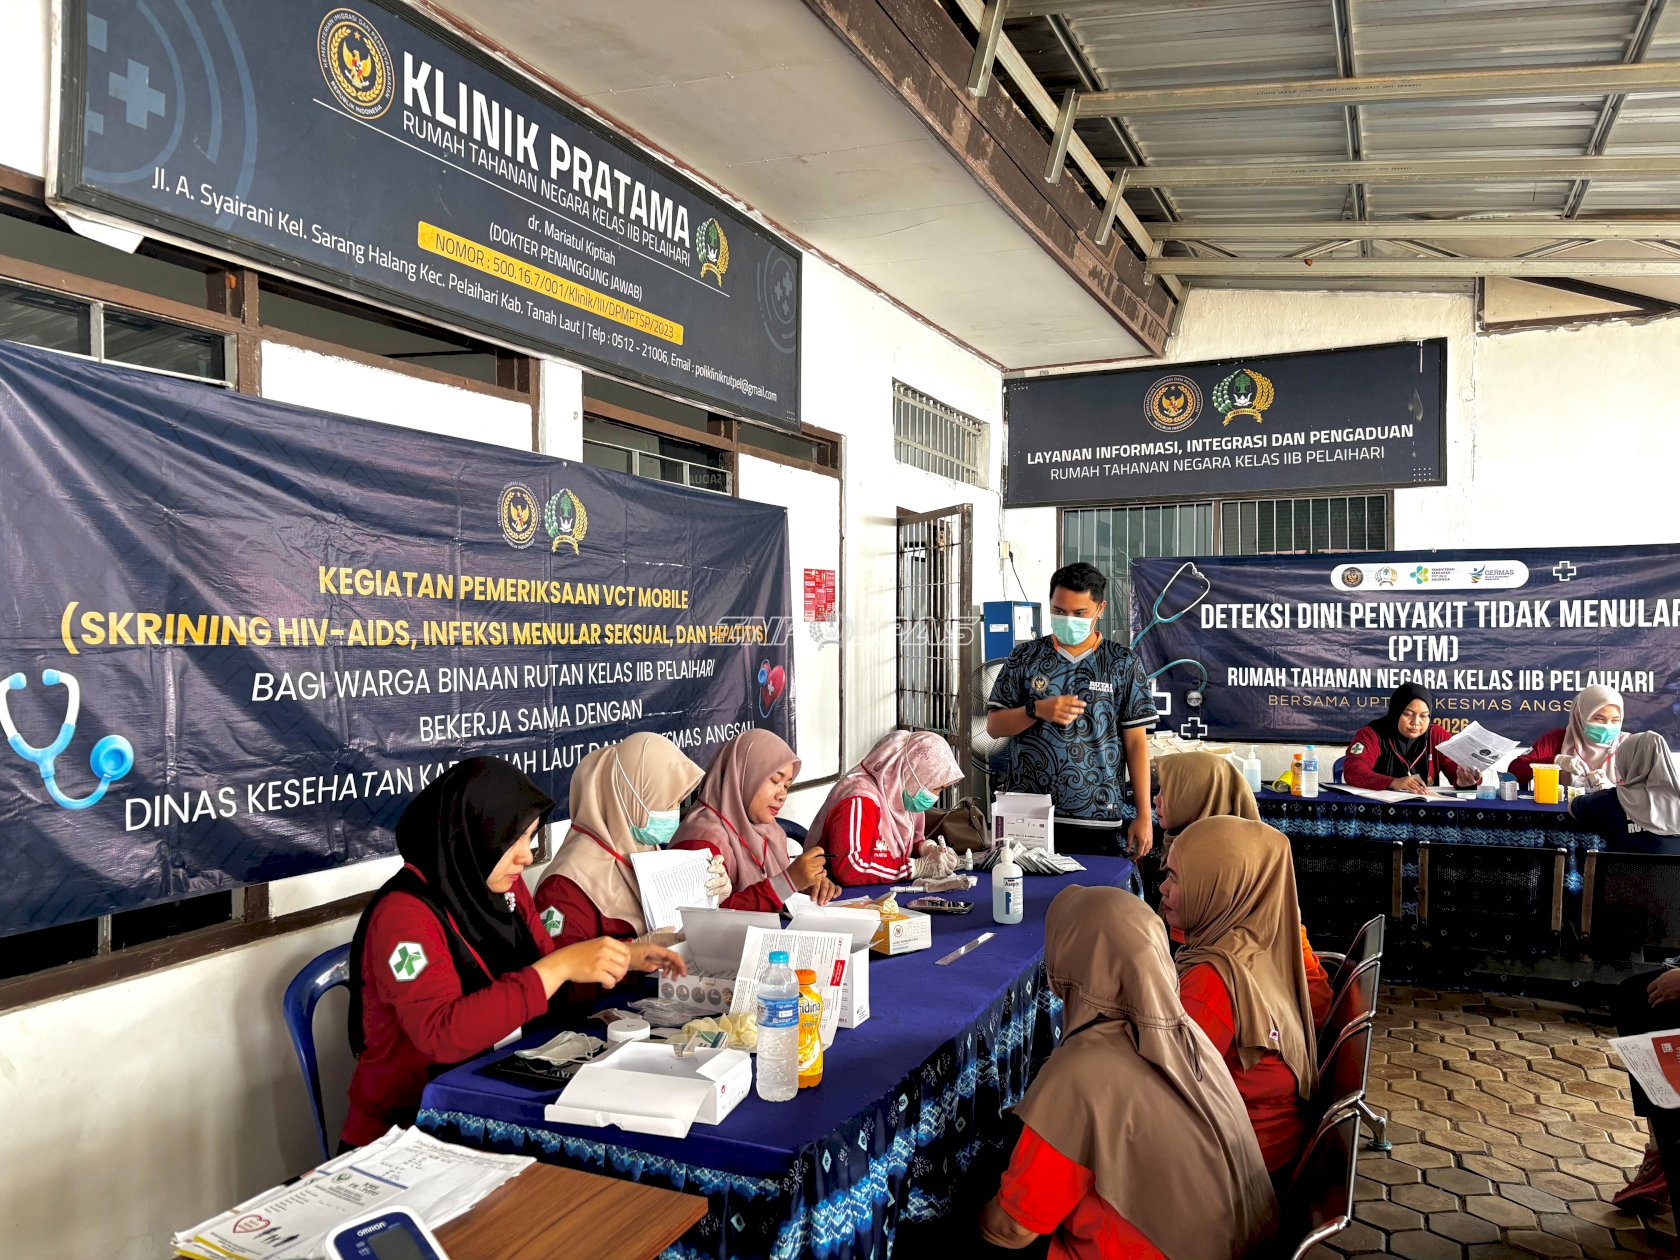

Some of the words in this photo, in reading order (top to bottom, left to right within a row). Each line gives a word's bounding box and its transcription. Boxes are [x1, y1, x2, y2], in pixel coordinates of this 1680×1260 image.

[404, 51, 540, 171] KLINIK
[550, 133, 690, 249] PRATAMA
[403, 110, 465, 158] RUMAH
[469, 142, 537, 193] TAHANAN
[541, 179, 589, 221] NEGARA
[593, 205, 625, 236] KELAS
[627, 222, 640, 243] IIB
[642, 230, 690, 268] PELAIHARI
[435, 233, 485, 268] NOMOR
[528, 214, 542, 233] dr.
[544, 221, 584, 252] Mariatul
[586, 237, 616, 266] Kiptiah
[489, 222, 538, 258] (DOKTER
[541, 247, 608, 287] PENANGGUNG
[610, 275, 642, 302] JAWAB)
[152, 167, 170, 192] Jl.
[175, 175, 195, 200] A.
[200, 184, 273, 227] Syairani
[278, 211, 308, 239] Kel.
[311, 224, 365, 264] Sarang
[368, 244, 417, 282] Halang
[420, 263, 445, 288] Kec.
[449, 273, 499, 305] Pelaihari
[501, 292, 523, 315] Kab.
[526, 301, 557, 326] Tanah
[559, 312, 580, 335] Laut
[612, 332, 634, 352] 0512
[642, 343, 669, 366] 21006,
[671, 353, 691, 371] Email
[695, 364, 778, 402] poliklinikrutpel@gmail.com
[1028, 448, 1092, 465] LAYANAN
[1096, 441, 1182, 459] INFORMASI,
[1187, 434, 1267, 453] INTEGRASI
[1272, 431, 1305, 447] DAN
[1310, 424, 1414, 445] PENGADUAN
[1050, 465, 1100, 480] RUMAH
[1103, 460, 1169, 476] TAHANAN
[1173, 456, 1231, 471] NEGARA
[1235, 452, 1280, 468] KELAS
[1284, 451, 1302, 465] IIB
[1306, 446, 1385, 464] PELAIHARI
[319, 566, 454, 600] KEGIATAN
[460, 576, 600, 605] PEMERIKSAAN
[602, 585, 635, 607] VCT
[638, 587, 689, 609] MOBILE
[60, 601, 272, 654] (SKRINING
[278, 617, 417, 650] HIV-AIDS,
[423, 620, 508, 646] INFEKSI
[513, 622, 601, 645] MENULAR
[605, 624, 673, 647] SEKSUAL,
[676, 625, 707, 644] DAN
[709, 620, 768, 646] HEPATITIS)
[1201, 603, 1290, 629] DETEKSI
[1297, 602, 1343, 629] DINI
[1350, 601, 1467, 629] PENYAKIT
[1474, 600, 1551, 628] TIDAK
[1388, 635, 1459, 662] (PTM)
[252, 671, 326, 702] BAGI
[334, 669, 431, 698] WARGA
[438, 666, 518, 693] BINAAN
[524, 664, 586, 688] RUTAN
[588, 662, 632, 685] KELAS
[636, 662, 653, 682] IIB
[657, 659, 715, 680] PELAIHARI
[1227, 667, 1286, 687] RUMAH
[1291, 667, 1374, 688] TAHANAN
[1376, 668, 1448, 689] NEGARA
[1454, 669, 1513, 690] KELAS
[1519, 669, 1544, 691] IIB
[1551, 670, 1654, 692] PELAIHARI
[420, 711, 512, 742] BEKERJA
[518, 703, 571, 731] SAMA
[575, 699, 643, 724] DENGAN
[1268, 694, 1350, 707] BERSAMA
[1435, 698, 1512, 711] KESMAS
[1519, 699, 1572, 712] ANGS
[125, 786, 237, 832] DINAS
[248, 768, 413, 813] KESEHATAN
[543, 744, 584, 772] LAUT
